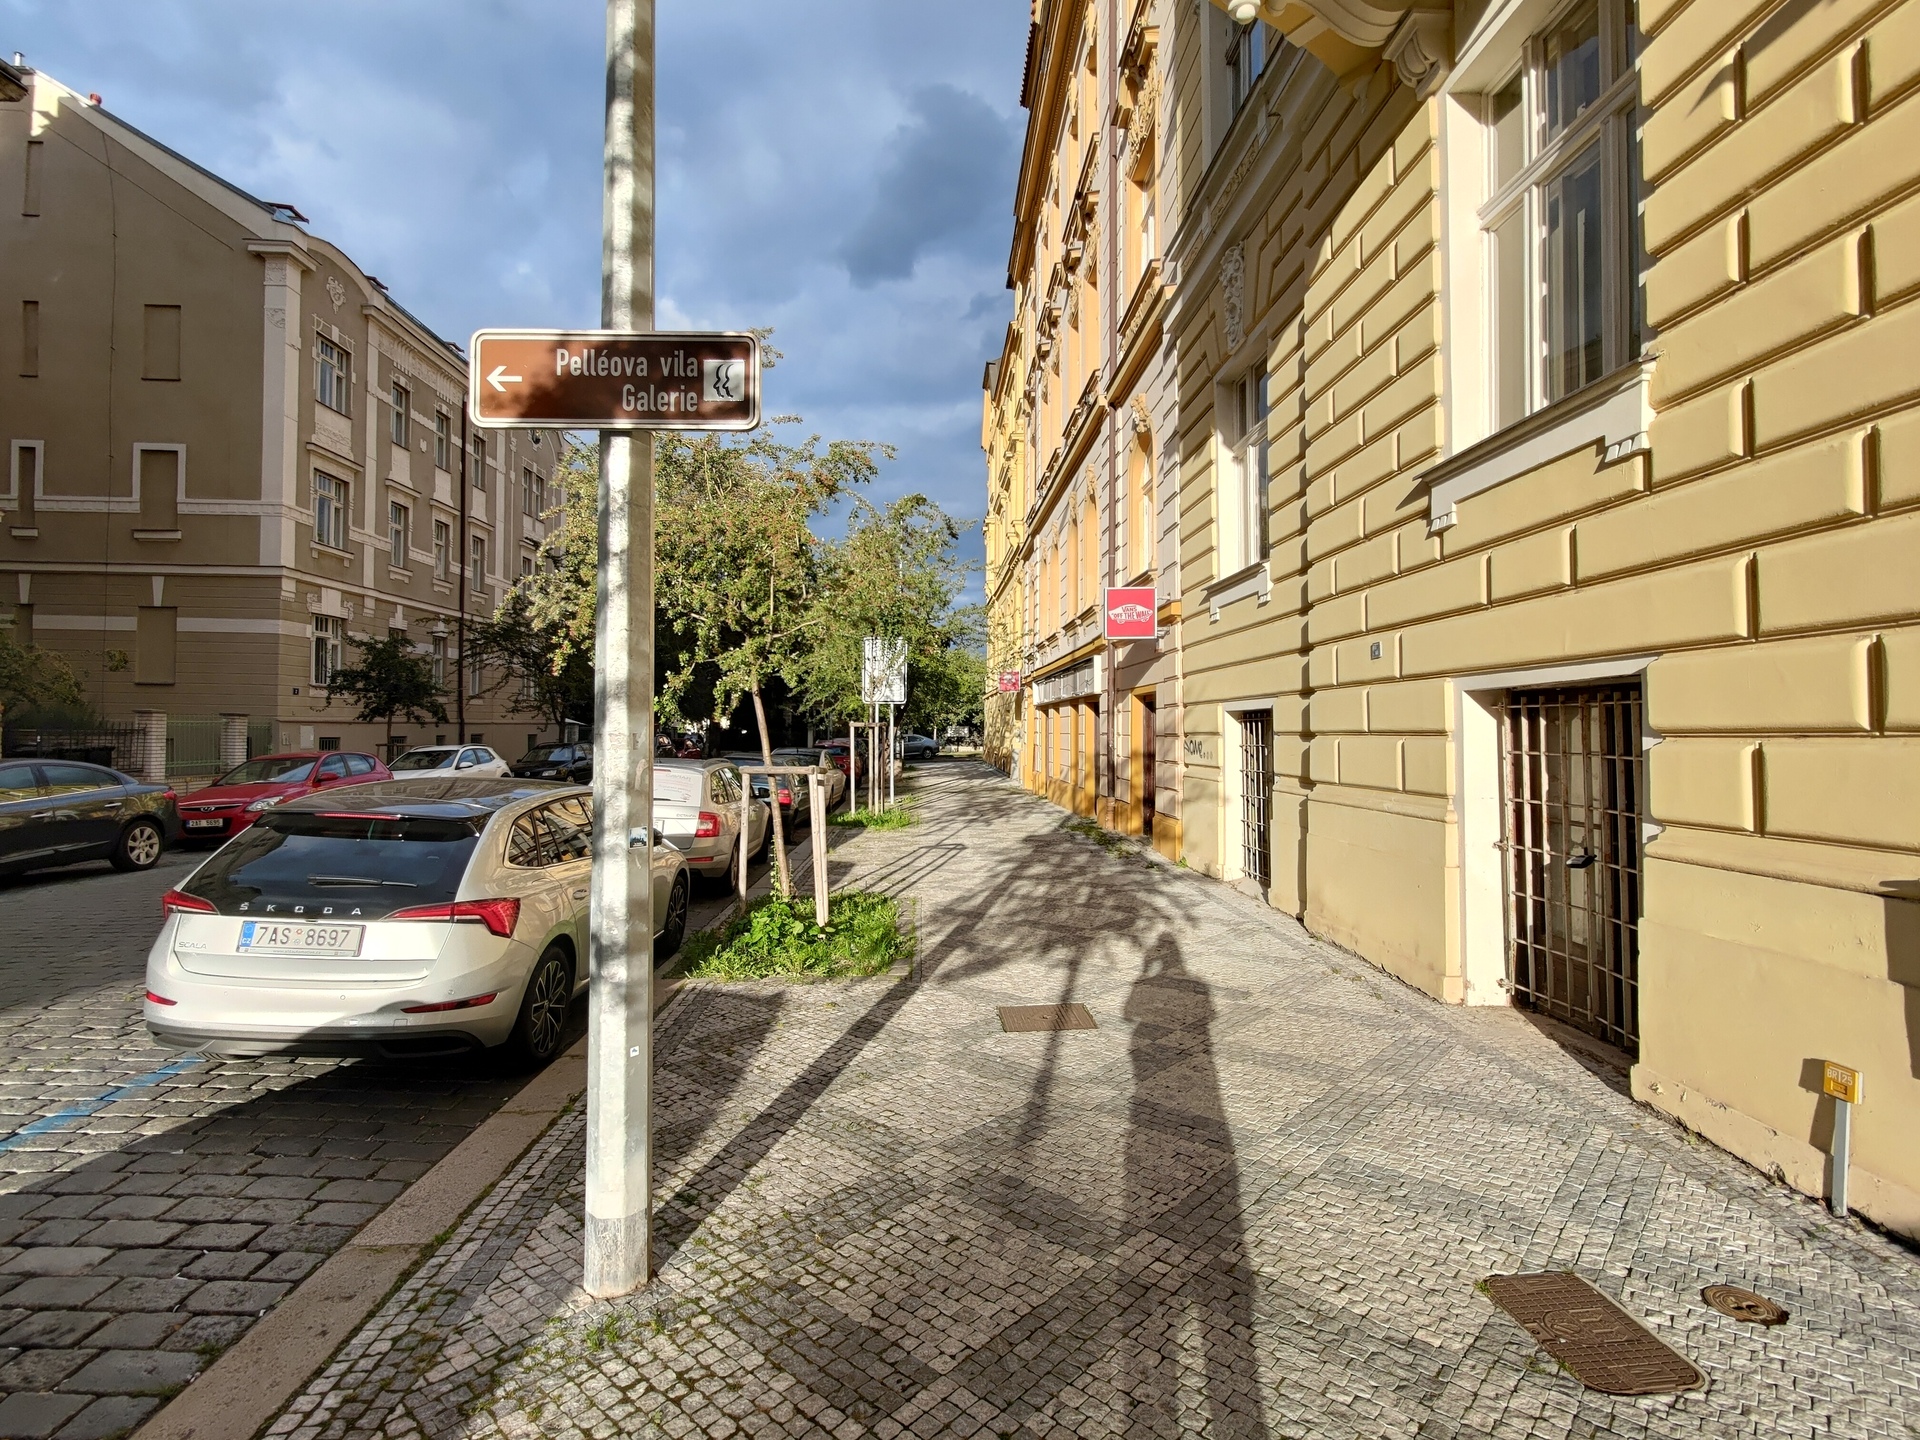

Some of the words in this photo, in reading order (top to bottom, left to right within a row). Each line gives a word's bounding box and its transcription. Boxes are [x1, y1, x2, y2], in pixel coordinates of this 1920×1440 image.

[556, 348, 648, 377] Pelléova
[660, 349, 698, 377] vila
[622, 383, 698, 412] Galerie
[1121, 605, 1137, 613] VANS
[1124, 612, 1135, 620] THE
[239, 902, 362, 915] ŠKODA
[256, 926, 292, 945] 7AS
[304, 928, 351, 948] 8697
[178, 941, 207, 950] SCALA
[1827, 1068, 1838, 1081] BR
[1841, 1074, 1853, 1086] 25
